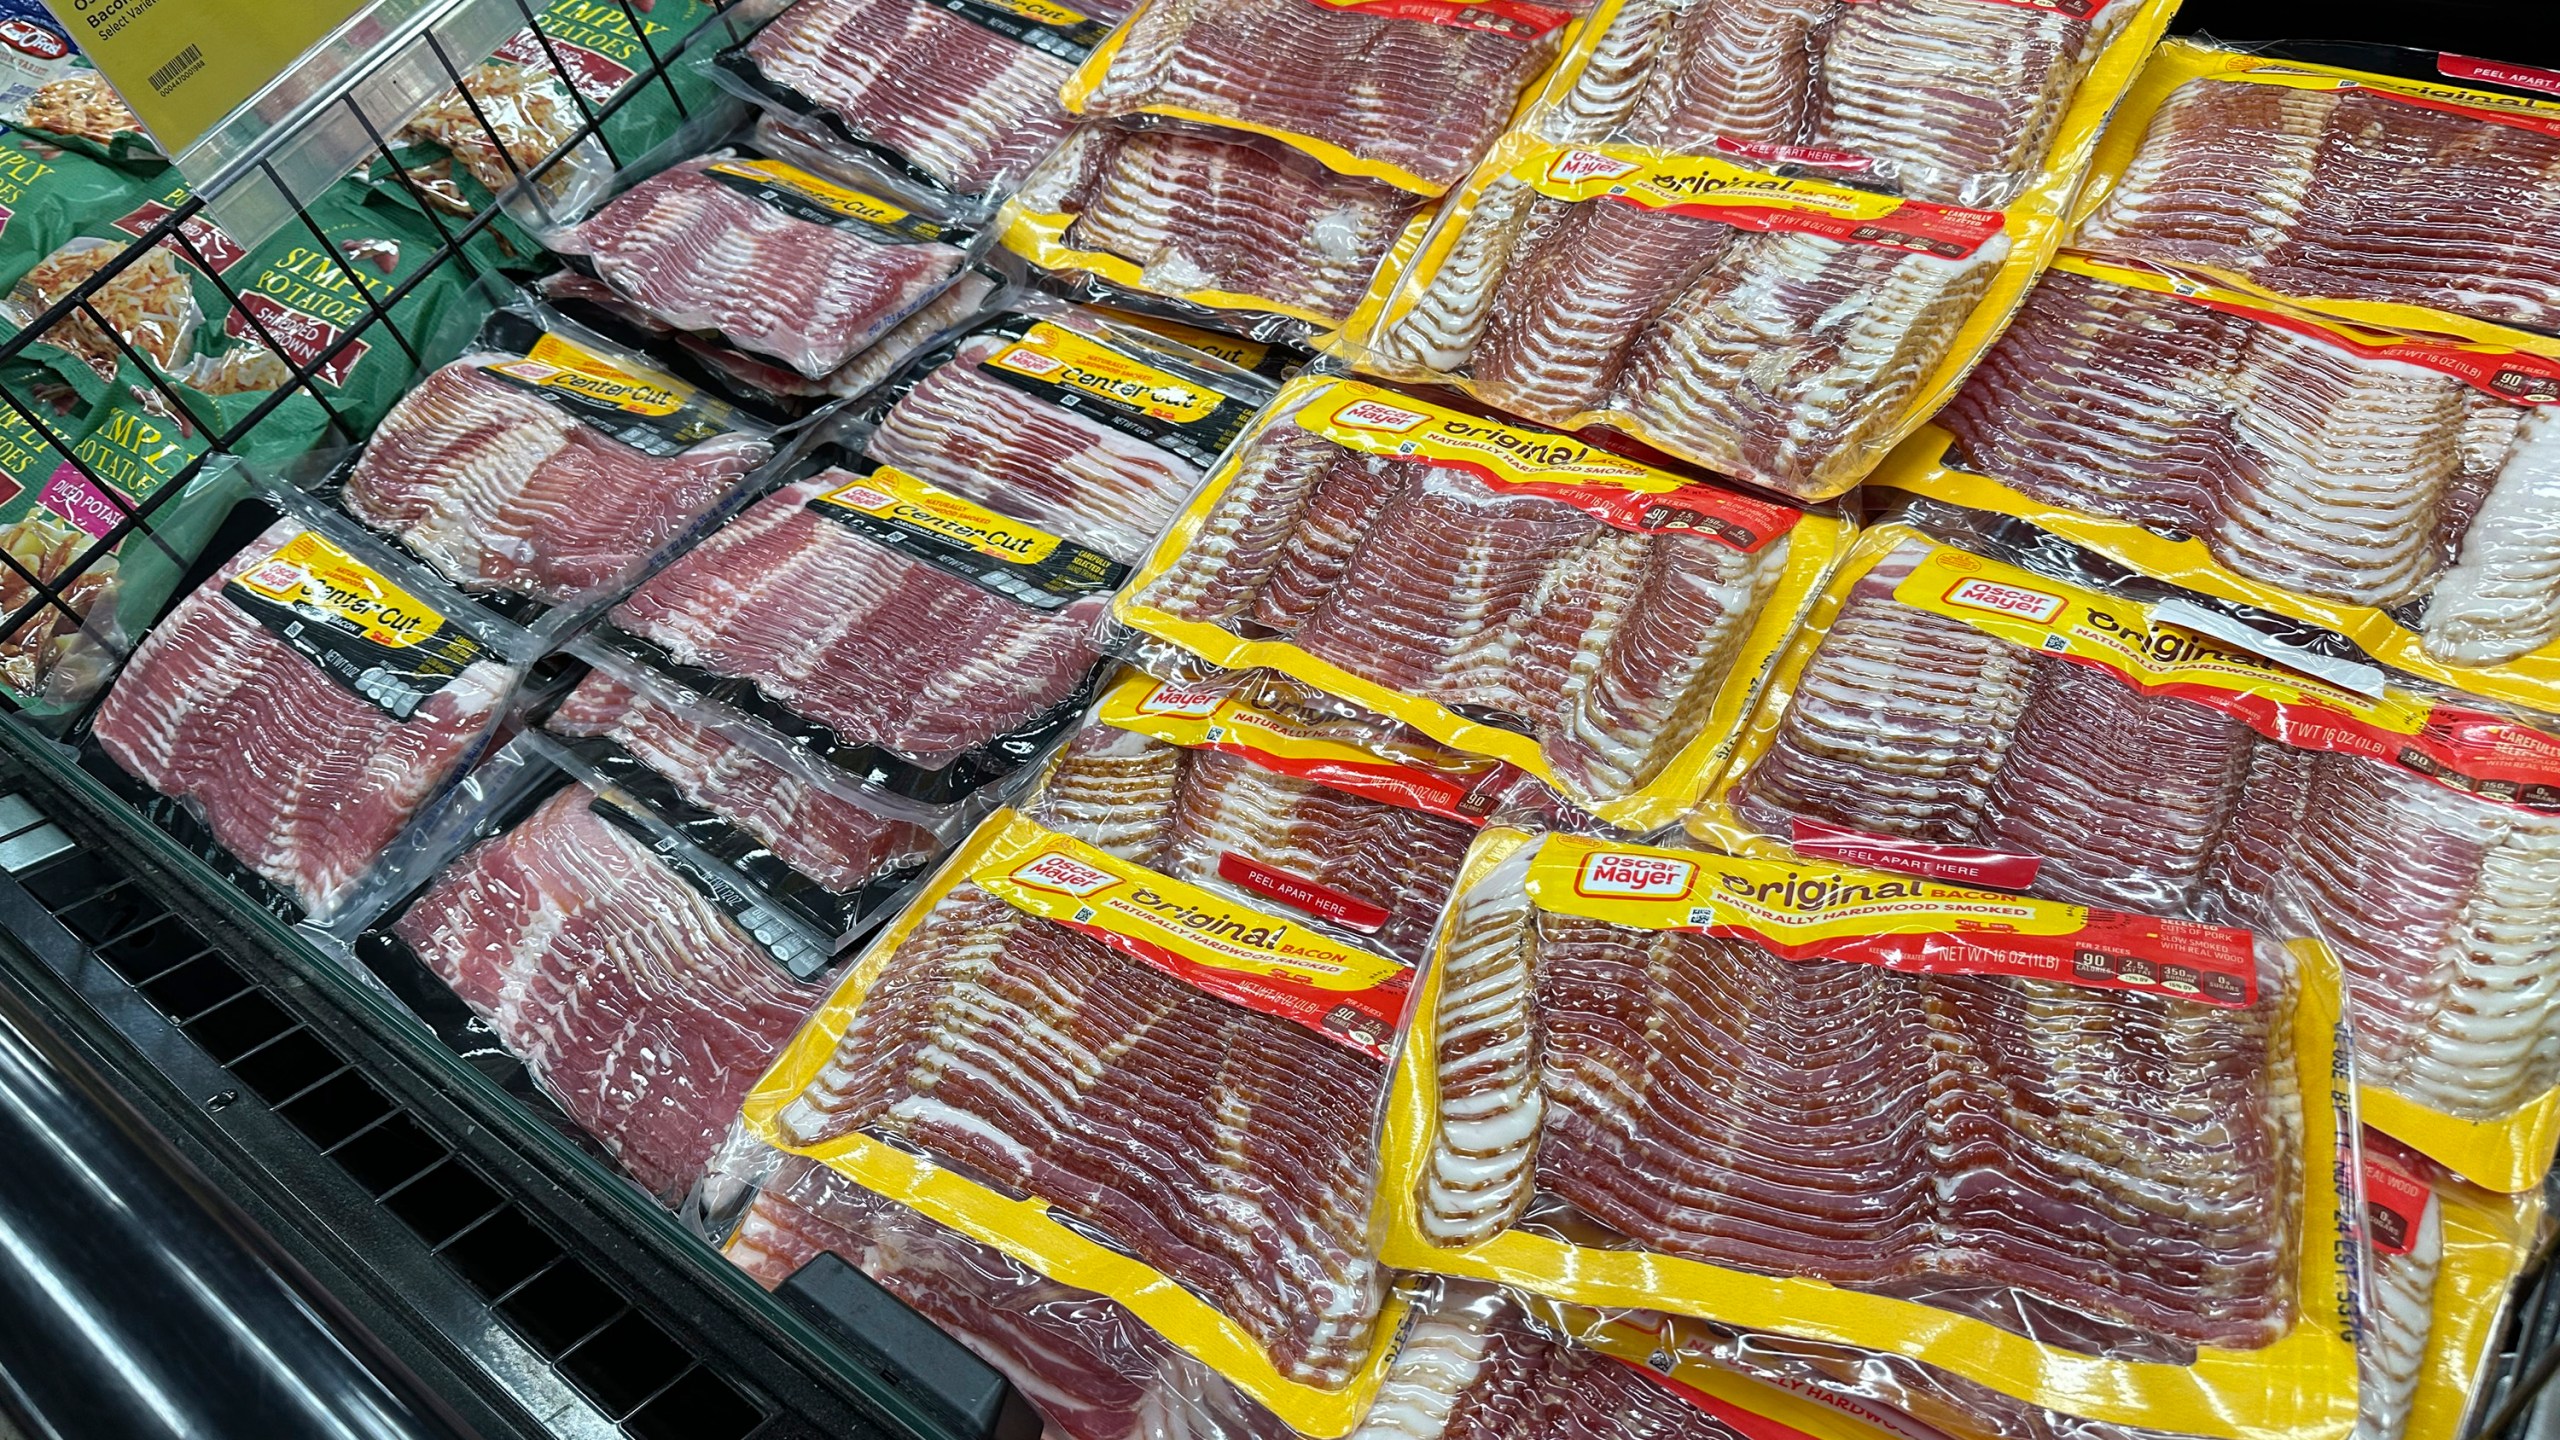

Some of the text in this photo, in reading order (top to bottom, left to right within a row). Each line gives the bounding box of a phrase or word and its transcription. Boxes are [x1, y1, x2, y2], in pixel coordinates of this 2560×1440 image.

[99, 0, 160, 41] Select Variet
[549, 0, 670, 42] IMPLY
[1026, 4, 1064, 20] Cut
[534, 13, 638, 60] OTATOES
[2474, 67, 2554, 88] PEEL APART
[1746, 143, 1838, 162] PEEL APART HERE
[843, 200, 886, 218] Cut
[1947, 209, 1994, 222] CAREFULLY
[1767, 213, 1786, 226] NET
[1785, 216, 1801, 226] WT
[1809, 221, 1823, 232] OZ
[1942, 216, 1983, 227] SELECTED
[1859, 228, 1878, 237] 90
[256, 270, 363, 327] POTATOE
[2380, 349, 2483, 379] NET WT 16 OZ (1LB)
[2500, 372, 2522, 387] 90
[553, 373, 674, 407] Center Cut
[1347, 407, 1413, 427] Mayer
[1359, 402, 1417, 420] Oscar
[1443, 420, 1589, 467] Original
[1427, 432, 1646, 477] NATURALLY SMOKED
[51, 479, 84, 506] DICED
[1555, 487, 1601, 507] NET WT 16
[925, 498, 970, 512] NATURALLY
[1650, 507, 1668, 520] 90
[893, 505, 1036, 554] Center Cut
[894, 519, 968, 547] ORIGINAL BACON
[1073, 556, 1102, 573] SELECTED
[1078, 549, 1113, 568] CAREFULLY
[257, 570, 294, 589] Mayer
[269, 564, 301, 580] Oscar
[1960, 590, 2048, 615] Mayer
[1972, 583, 2050, 606] Oscar
[378, 606, 422, 634] Cut
[2086, 606, 2274, 671] Original
[2075, 627, 2172, 674] NATURALLY
[2173, 660, 2286, 684] HARDWOOD
[2290, 680, 2371, 709] SMOKED
[1151, 691, 1220, 711] Mayer
[1233, 711, 1314, 738] NATURALLY
[2299, 720, 2322, 740] WT
[2322, 726, 2336, 742] 16
[2335, 730, 2356, 745] OZ
[2354, 737, 2387, 757] (1LB)
[2407, 750, 2429, 767] 90
[2486, 759, 2511, 769] WITH
[2512, 761, 2539, 771] REAL
[1414, 787, 1430, 800] OZ
[1427, 790, 1452, 805] (1LB)
[1468, 793, 1485, 806] 90
[1458, 802, 1485, 814] CALORIES
[1045, 857, 1110, 881] Oscar
[1600, 855, 1682, 872] Oscar
[1838, 848, 1980, 878] PEEL APART HERE
[1027, 864, 1098, 889] Mayer
[1592, 864, 1681, 891] Mayer
[1248, 870, 1348, 917] PEEL APART HERE
[1718, 871, 2019, 912] Original BACON
[1716, 892, 2029, 926] NATURALLY HARDWOOD SMOKED
[1131, 887, 1349, 964] Original BACON
[2160, 924, 2233, 943] CUTS OF PORK
[1108, 899, 1341, 974] NATURALLY HARDWOOD SMOKED
[2160, 934, 2230, 953] SLOW SMOKED
[1938, 945, 1965, 962] NET
[1967, 946, 1991, 963] WT
[1993, 951, 2006, 964] 16
[2008, 951, 2028, 966] OZ
[2027, 952, 2060, 970] (1LB)
[2075, 940, 2132, 956] PER 2 SLICES
[2160, 942, 2245, 964] WITH REAL WOOD
[2083, 952, 2105, 968] 90
[2125, 959, 2150, 972] 2.5g
[2164, 965, 2198, 981] 350mg
[2217, 975, 2232, 986] 0g
[2209, 982, 2241, 994] SUGARS
[1335, 1007, 1355, 1021] 90
[1361, 1004, 1384, 1018] SLICES
[2332, 1049, 2351, 1080] USE
[2332, 1090, 2350, 1114] BY
[2386, 1176, 2419, 1198] WOOD
[2333, 1209, 2352, 1234] 24
